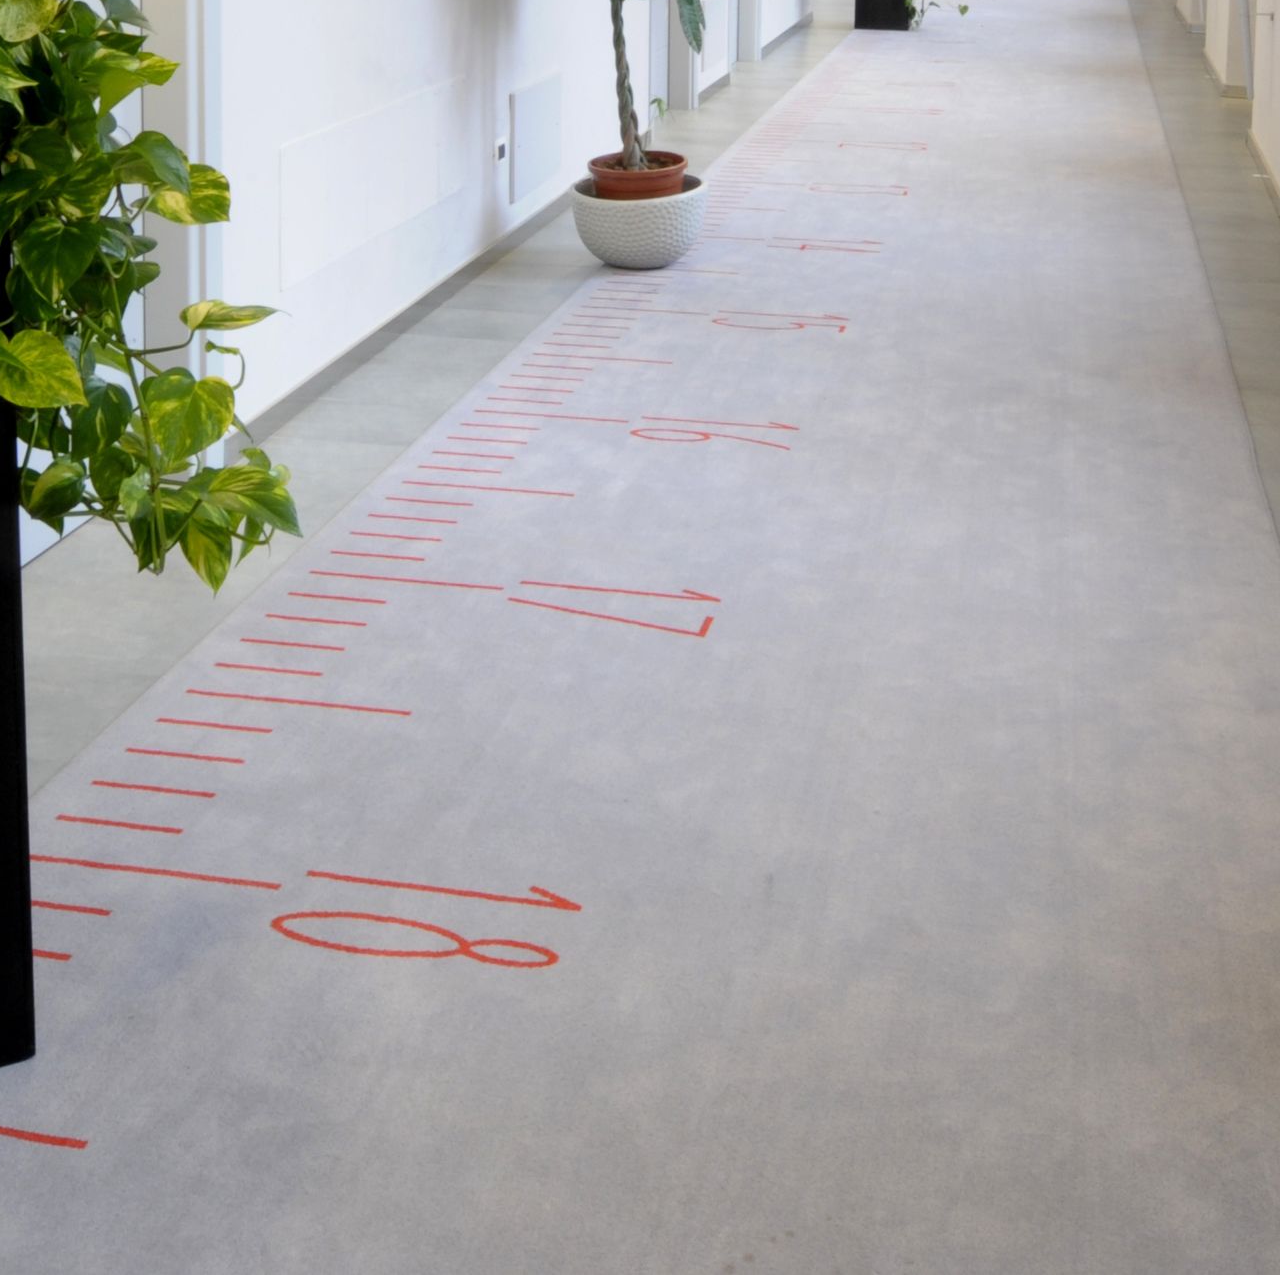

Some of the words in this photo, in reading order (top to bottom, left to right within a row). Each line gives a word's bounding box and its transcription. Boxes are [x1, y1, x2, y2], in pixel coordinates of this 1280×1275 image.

[766, 236, 885, 253] 14
[711, 310, 850, 333] 15
[629, 415, 801, 451] 16
[508, 581, 721, 637] 17
[270, 870, 582, 968] 18
